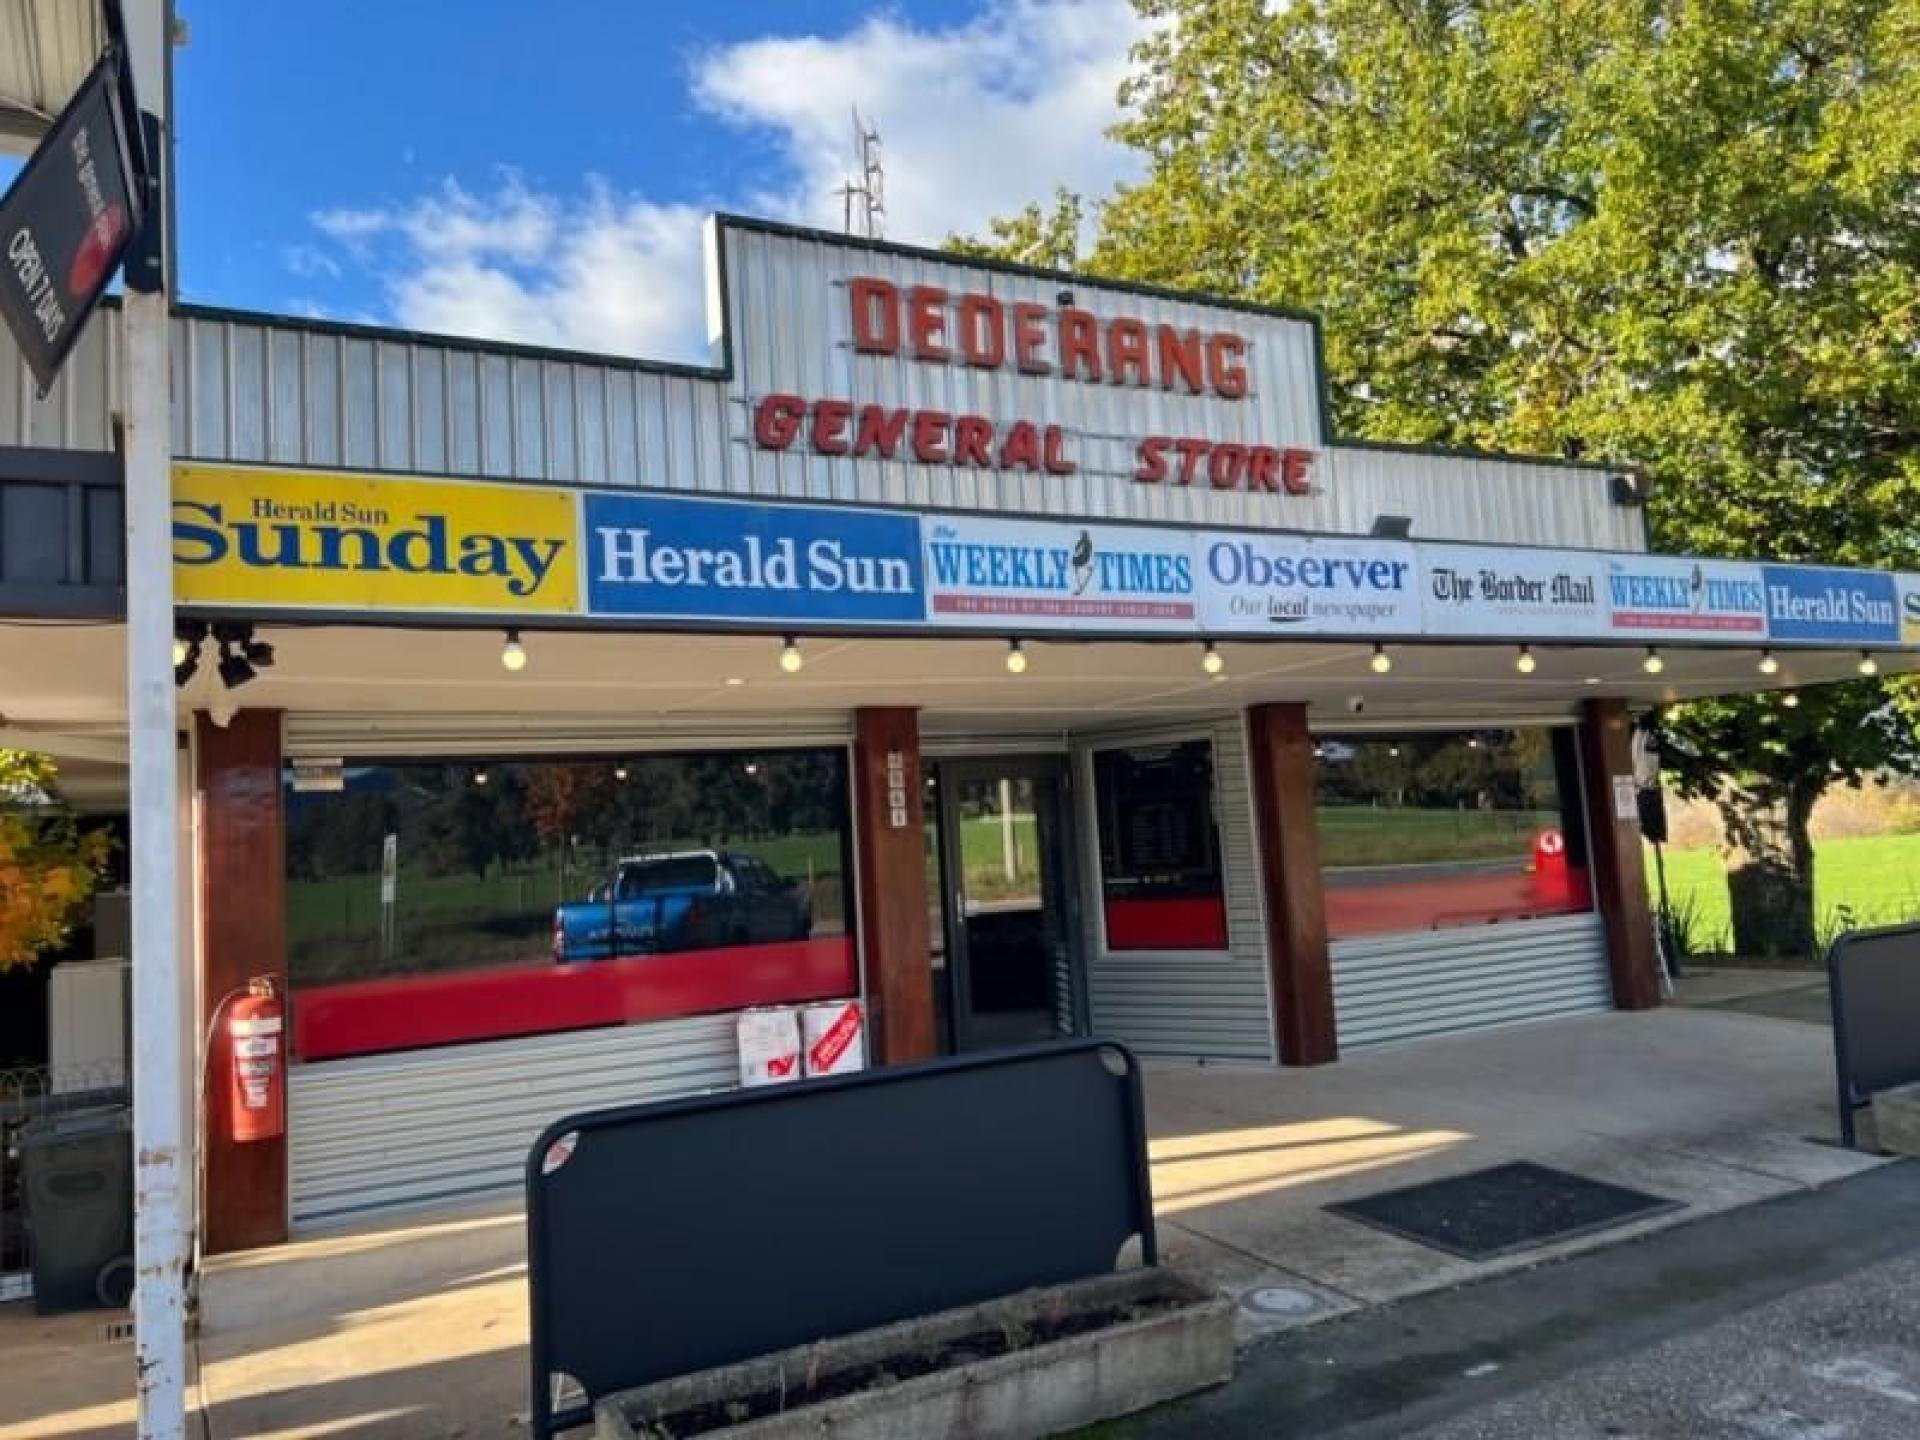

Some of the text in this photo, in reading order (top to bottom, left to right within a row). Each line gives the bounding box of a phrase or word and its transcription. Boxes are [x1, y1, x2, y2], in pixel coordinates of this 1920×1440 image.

[848, 276, 1249, 399] DEDERANG
[753, 393, 1317, 495] GENERAL STORE
[252, 497, 390, 525] Herald Sun
[172, 500, 567, 596] Sunday
[595, 527, 915, 593] Herald Sun
[929, 542, 1192, 594] WEEKLY TIMES
[1208, 541, 1409, 590] Observer
[1230, 594, 1398, 624] Our local newspaper
[1431, 568, 1595, 604] The Border Mail
[1610, 575, 1762, 611] WEEKLY TIMES
[1767, 585, 1851, 621] Herald
[1852, 591, 1895, 625] Sun
